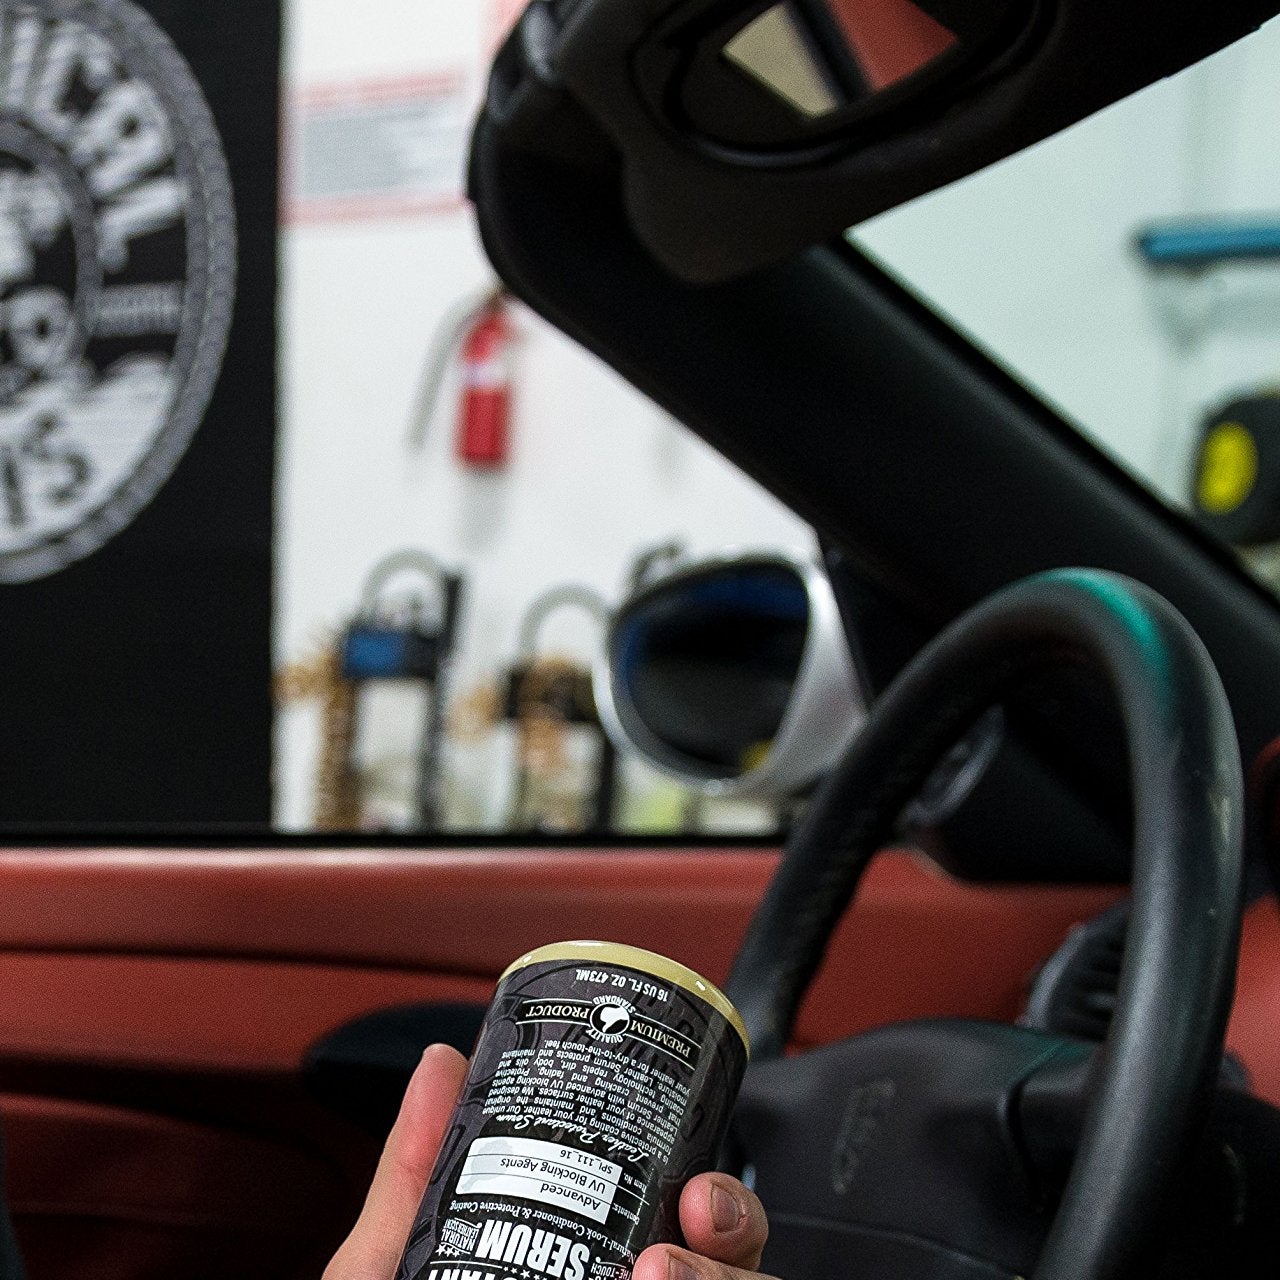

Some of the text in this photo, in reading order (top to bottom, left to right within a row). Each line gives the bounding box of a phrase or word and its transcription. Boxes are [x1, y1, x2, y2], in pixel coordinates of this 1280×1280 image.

[575, 969, 667, 1001] 16 US FL. OZ. 473ML
[593, 995, 635, 1012] STANDARD
[525, 1005, 690, 1057] PREMIUM PRODUCT
[544, 1040, 560, 1049] feel.
[586, 1029, 622, 1043] QUALITY
[561, 1041, 629, 1064] dry-to-the-touch
[501, 1049, 687, 1106] moisture. Leather Serum protects and maintains
[637, 1062, 649, 1073] for
[650, 1068, 674, 1087] leather
[495, 1066, 680, 1126] that prevent cracking and fading. Protective
[497, 1056, 683, 1115] coating technology repels dirt, body oils and
[675, 1082, 690, 1096] your
[488, 1086, 675, 1144] appearance of your leather surfaces. We designed
[492, 1075, 677, 1136] Leather Serum with advanced UV blocking agents
[482, 1105, 668, 1165] is a protective coating for your leather. Our unique
[484, 1095, 671, 1155] formula conditions and maintains the original
[495, 1114, 648, 1161] Leather Protectant Serum
[560, 1149, 612, 1174] SPI_111_16
[500, 1158, 605, 1193] UV Blocking Agents
[623, 1173, 647, 1193] Item No.
[540, 1183, 600, 1210] Advanced
[610, 1201, 640, 1225] Contents:
[440, 1228, 475, 1251] NATURAL
[449, 1200, 636, 1264] Natural-Look Conditioner & Protective Coating
[590, 1262, 631, 1280] THE-TOUCH
